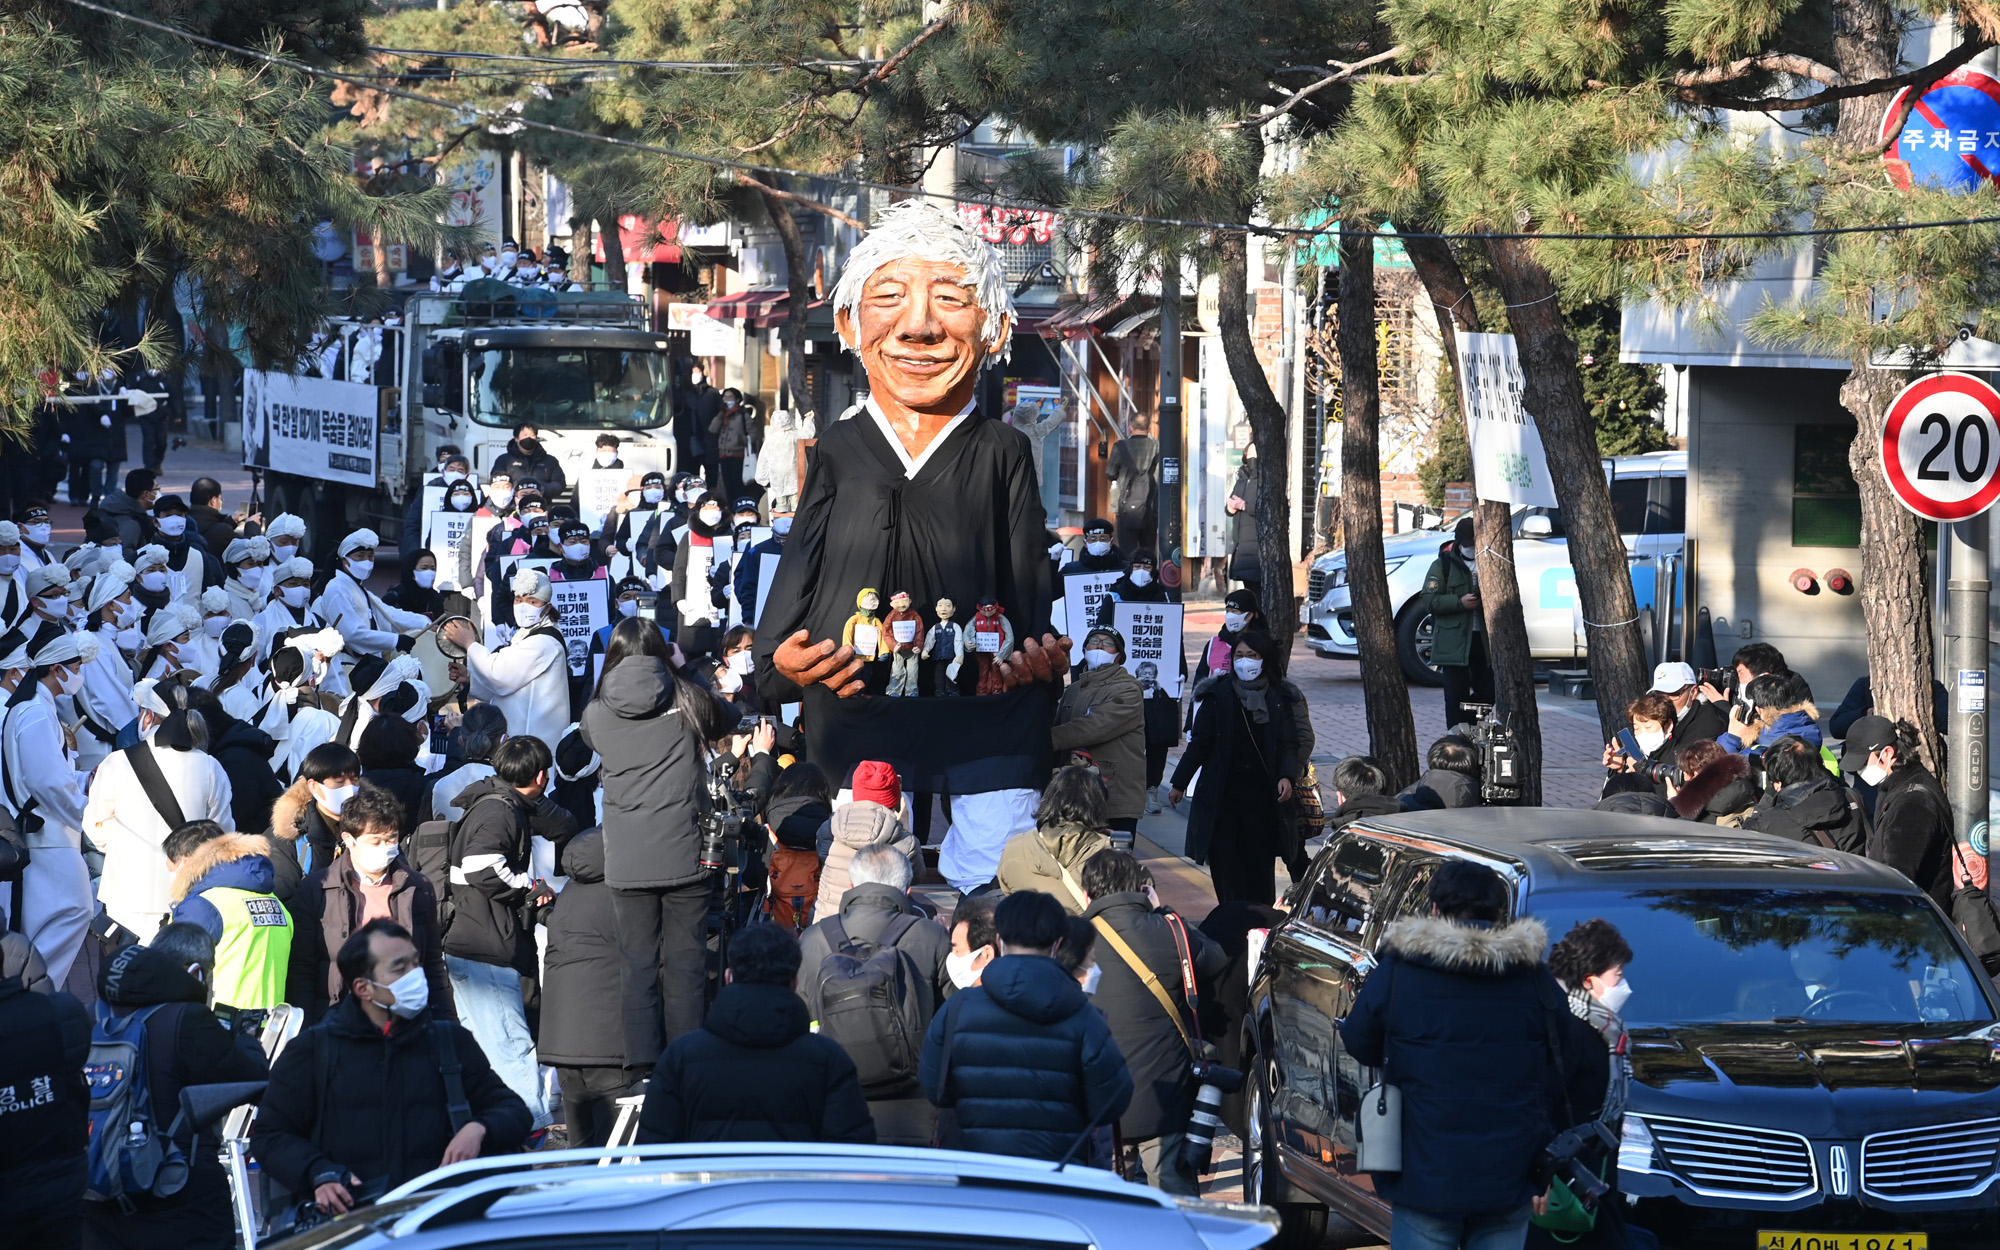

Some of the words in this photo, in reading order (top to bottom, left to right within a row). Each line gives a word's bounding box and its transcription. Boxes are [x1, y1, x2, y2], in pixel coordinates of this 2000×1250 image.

[272, 403, 280, 437] 딱
[281, 404, 289, 438] 한
[290, 405, 299, 439] 발
[322, 410, 346, 446] 목숨을
[347, 413, 373, 451] 걸어라!
[1917, 412, 1990, 483] 20
[1083, 585, 1092, 594] 딱
[1093, 584, 1103, 593] 한
[556, 592, 566, 602] 딱
[568, 592, 577, 602] 한
[578, 591, 588, 601] 발
[557, 602, 590, 614] 떼기에
[558, 614, 590, 626] 목숨을
[1132, 614, 1142, 624] 딱
[1143, 614, 1153, 624] 한
[1154, 614, 1164, 624] 발
[560, 626, 591, 637] 걸어라!
[1132, 625, 1164, 636] 떼기에
[1131, 636, 1163, 649] 목숨을
[1131, 648, 1162, 660] 걸어라!
[1971, 747, 1980, 785] 소나무길
[253, 915, 284, 925] POLICE
[0, 1091, 55, 1116] POLICE
